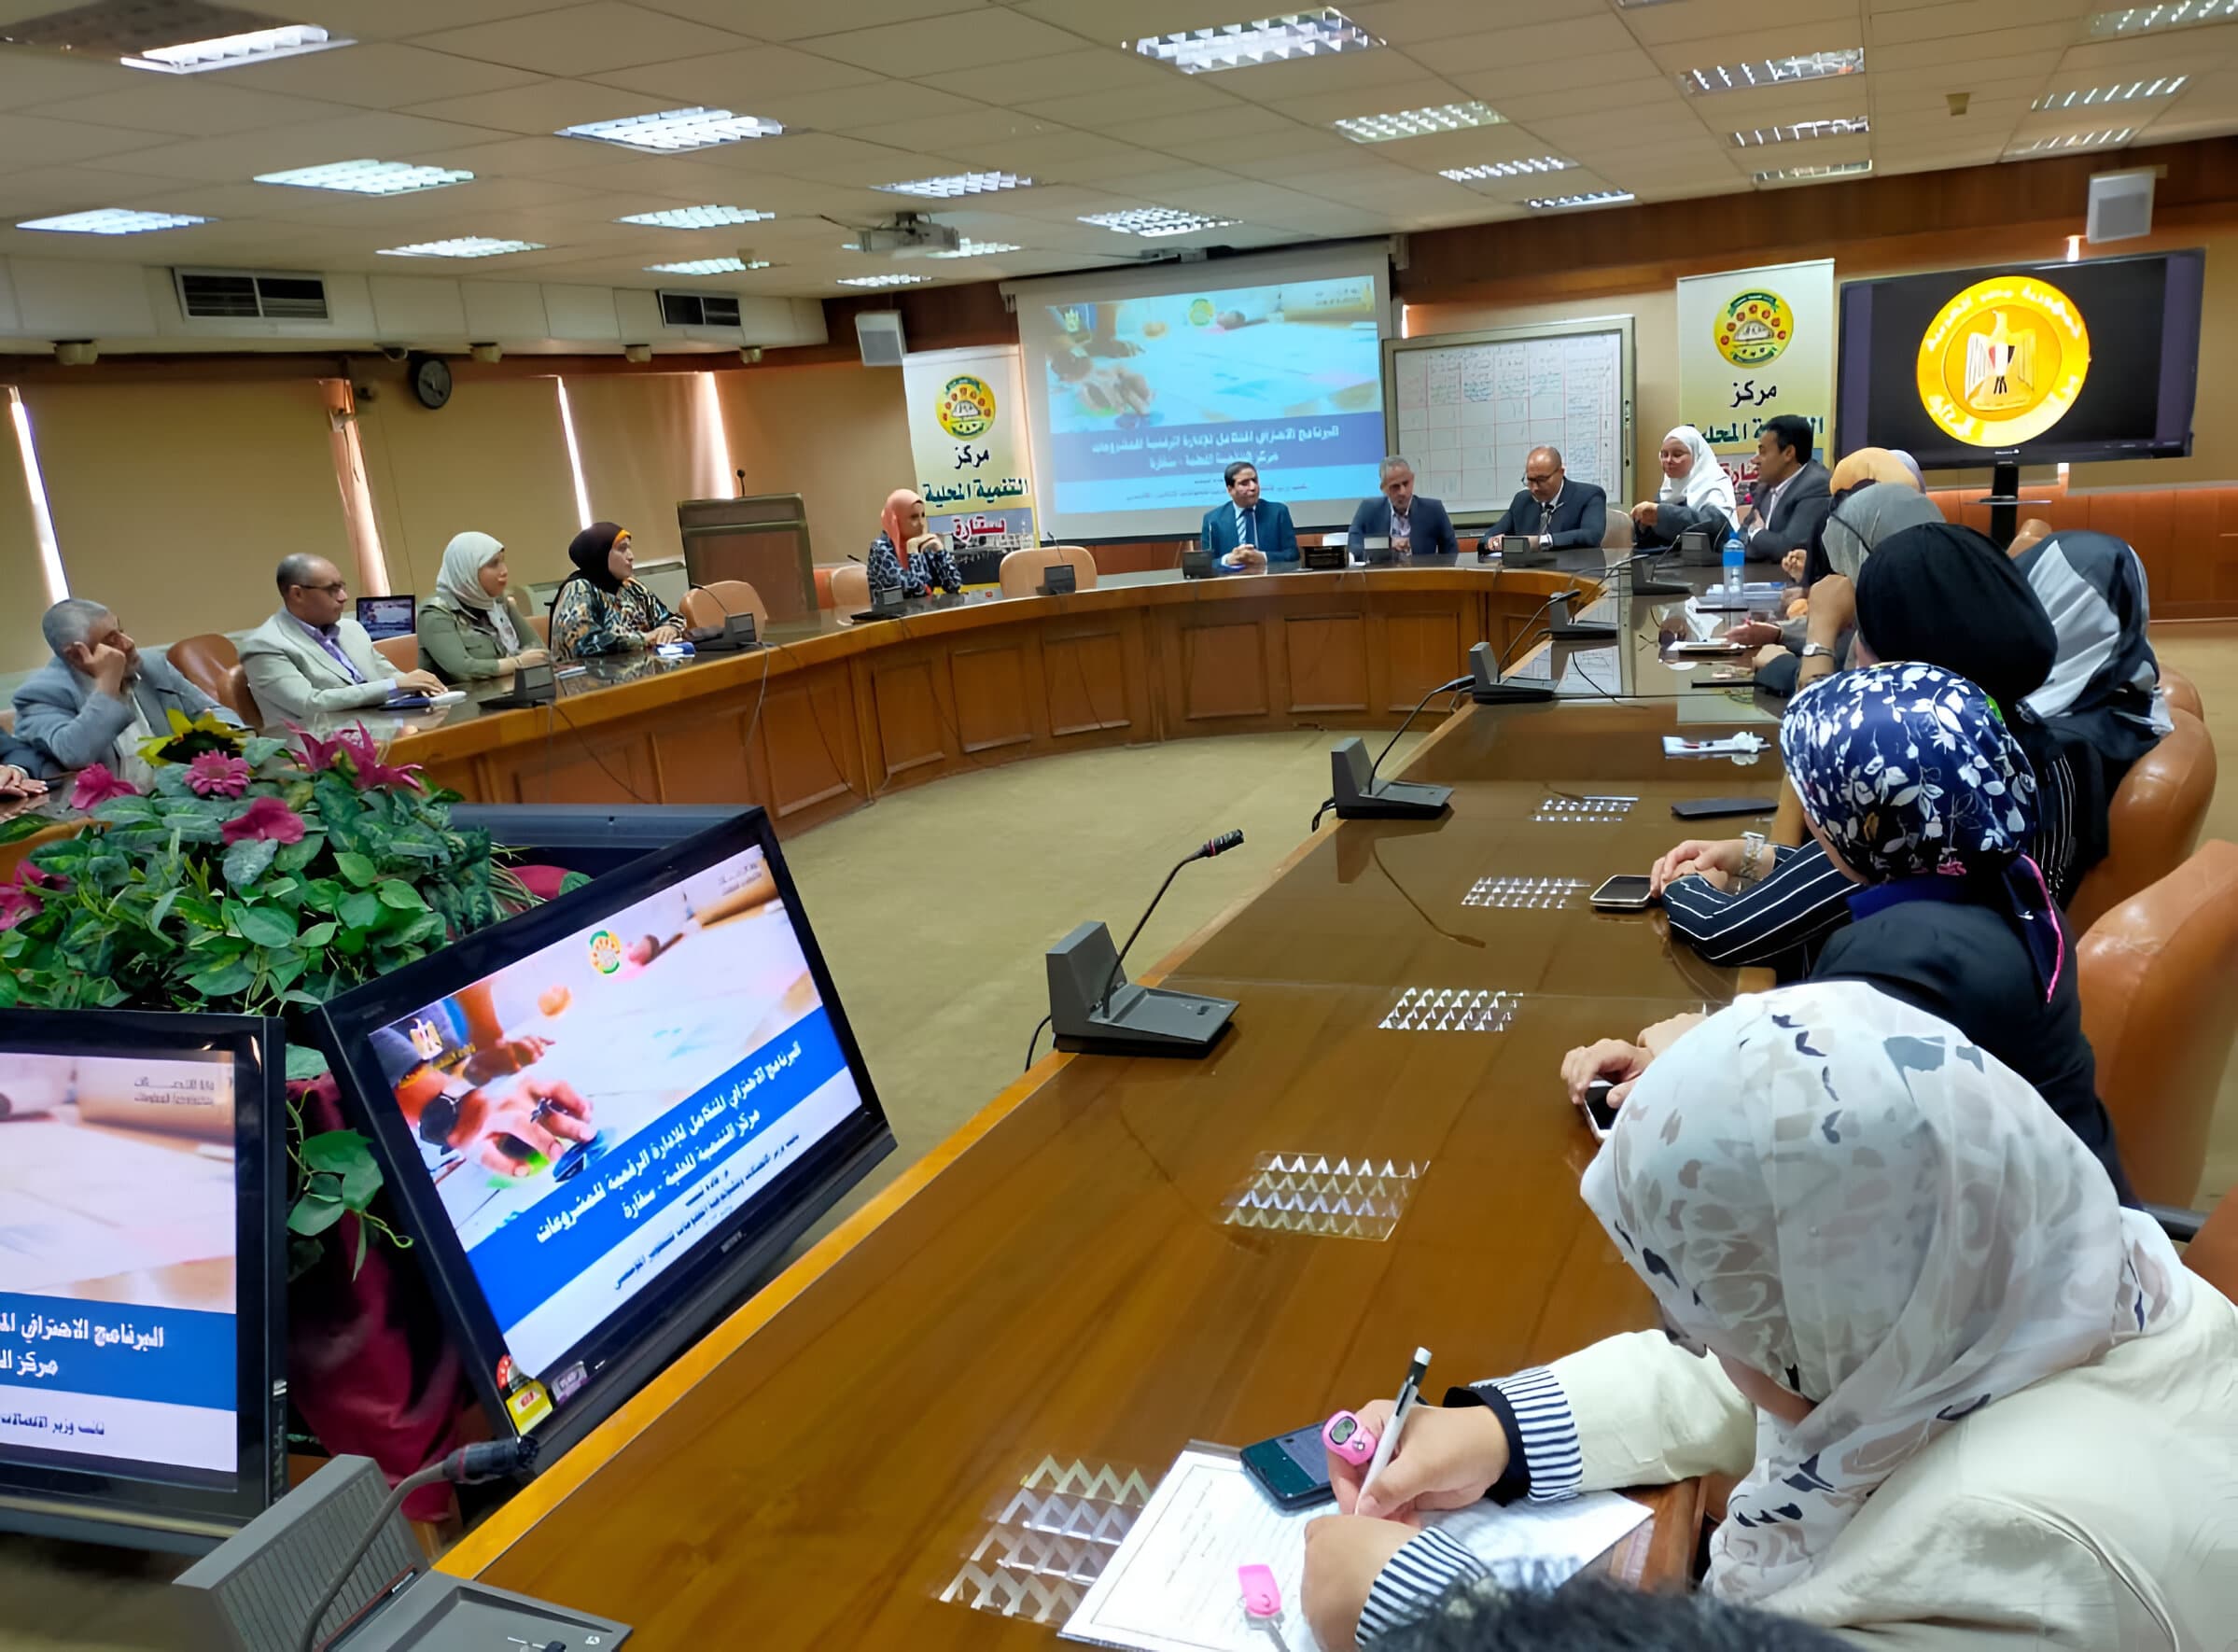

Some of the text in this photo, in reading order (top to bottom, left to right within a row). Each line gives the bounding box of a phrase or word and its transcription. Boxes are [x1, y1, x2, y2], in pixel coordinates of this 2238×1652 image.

[1729, 380, 1778, 408] مركز
[954, 445, 989, 469] مركز
[922, 477, 1028, 508] التنمية المحلية
[764, 1041, 802, 1080] البرنامج
[738, 1110, 761, 1137] مركز
[622, 1183, 656, 1220] سقارة
[21, 1313, 89, 1344] الاحترافي
[93, 1323, 164, 1351] البرنامج
[17, 1351, 58, 1378] مركز
